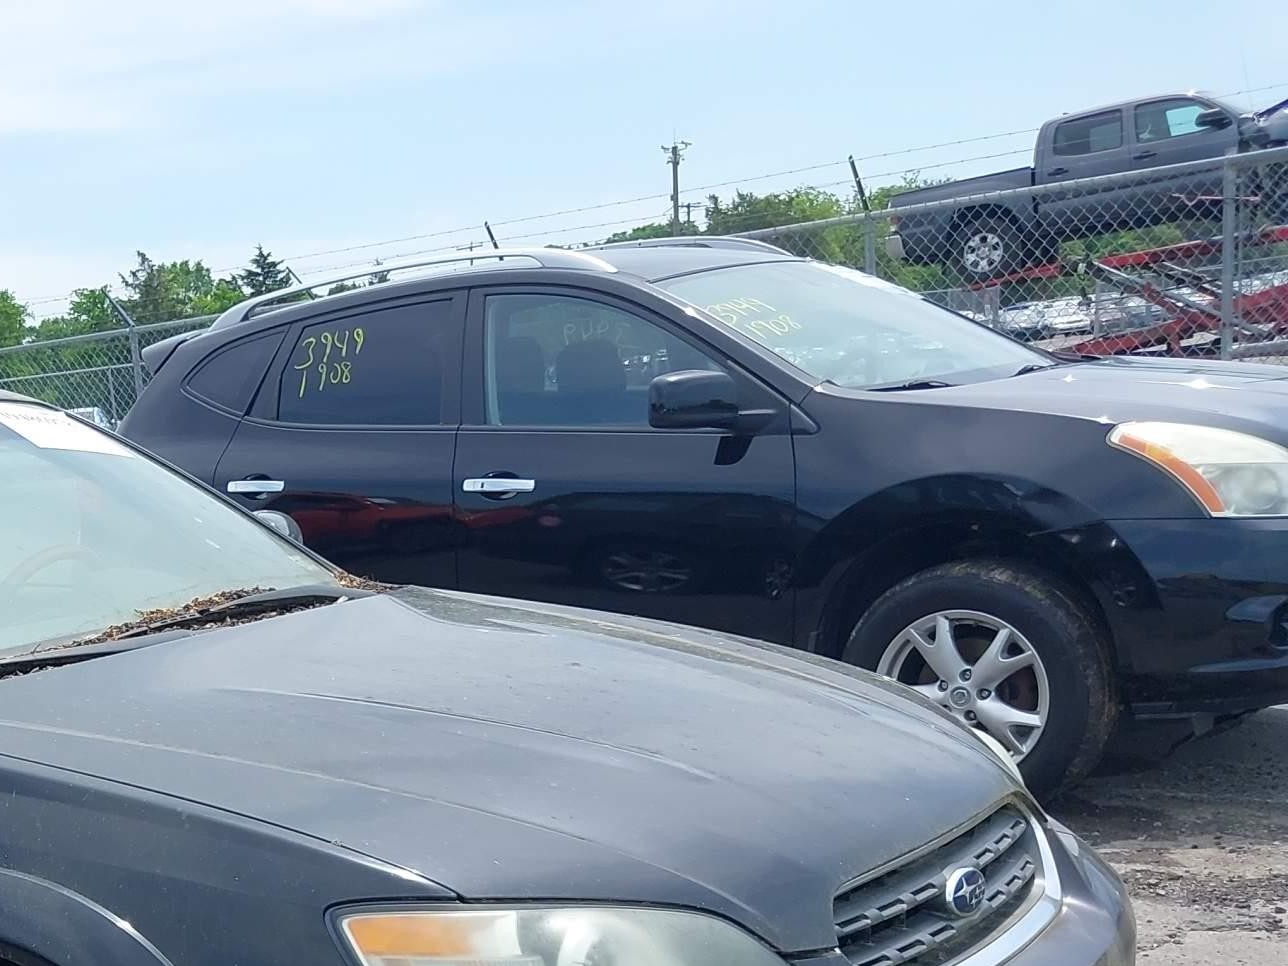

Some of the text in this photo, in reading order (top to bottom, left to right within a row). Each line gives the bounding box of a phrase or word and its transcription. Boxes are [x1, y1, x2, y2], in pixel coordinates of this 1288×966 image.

[743, 314, 802, 340] 1908
[294, 327, 365, 370] 3949
[298, 361, 353, 399] 1908
